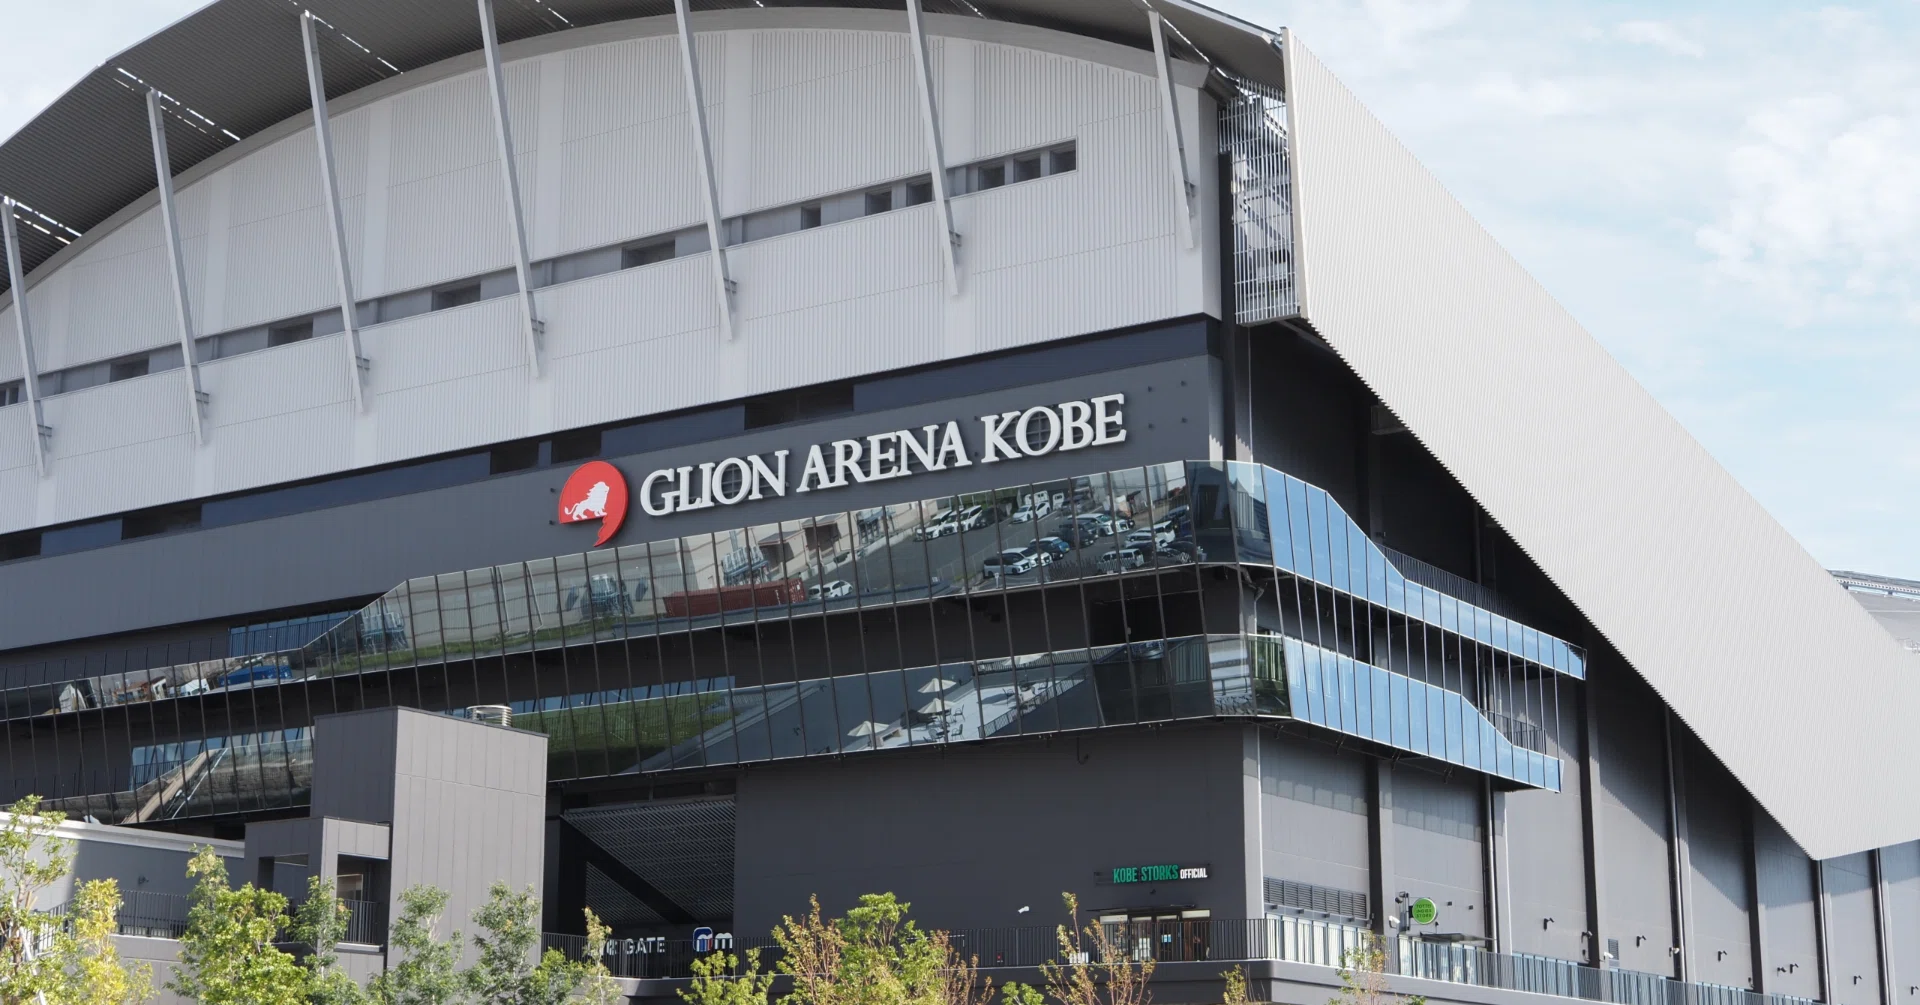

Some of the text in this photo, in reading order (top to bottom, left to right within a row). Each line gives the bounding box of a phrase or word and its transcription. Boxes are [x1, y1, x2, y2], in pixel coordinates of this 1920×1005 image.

[641, 393, 1127, 516] GLION ARENA KOBE
[1113, 865, 1208, 884] KOBE STORKS OFFICIAL
[625, 936, 666, 954] GATE
